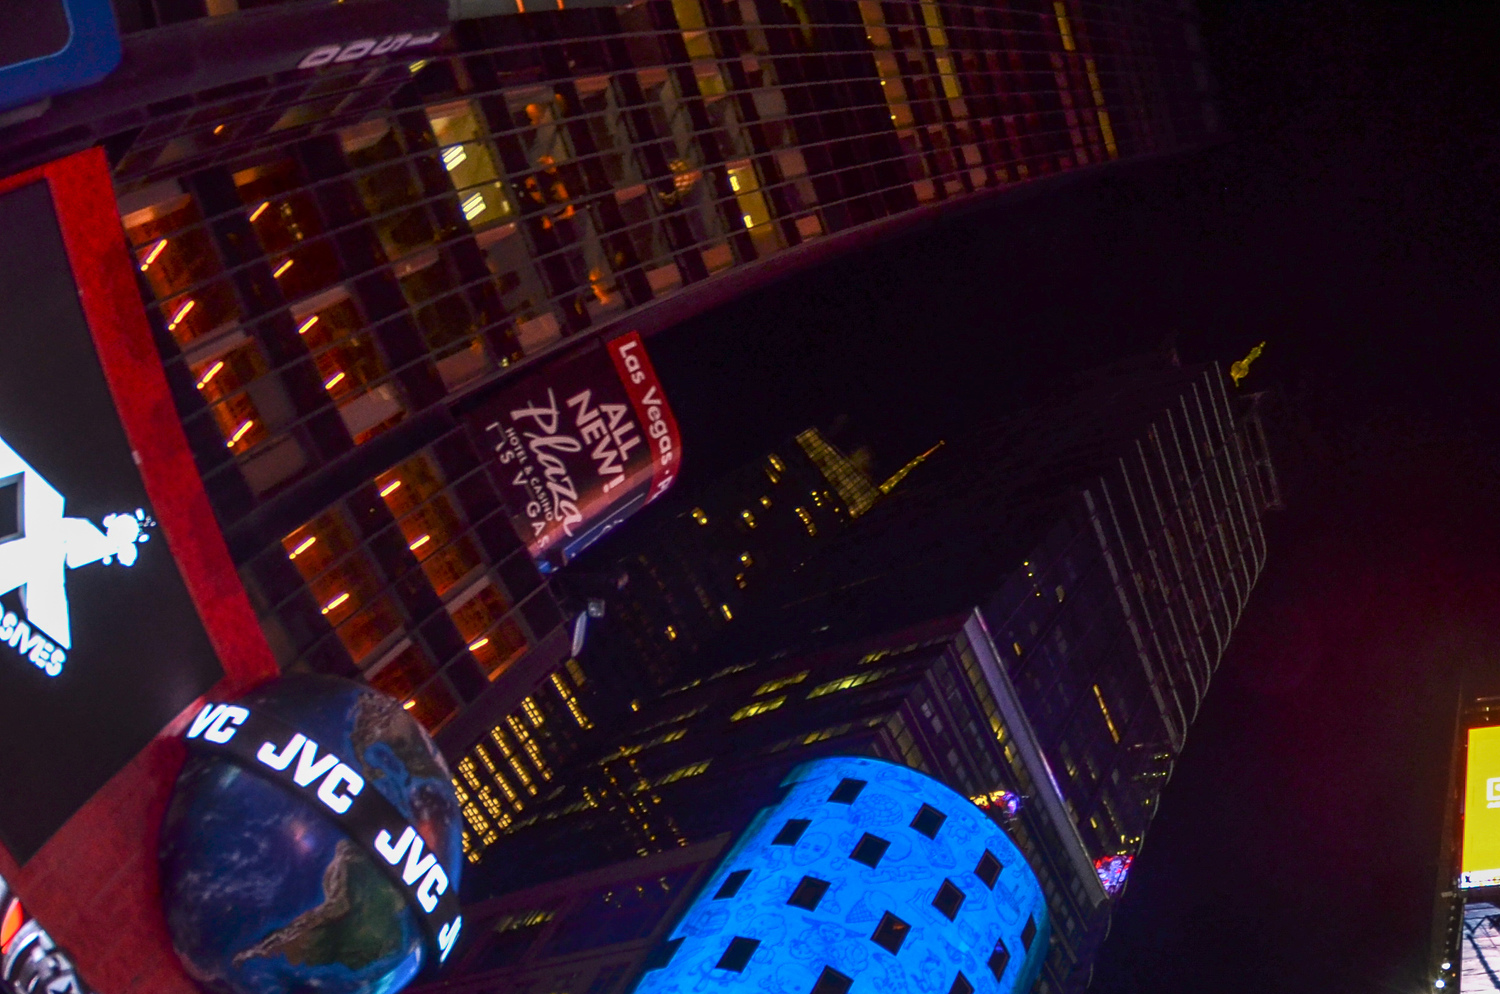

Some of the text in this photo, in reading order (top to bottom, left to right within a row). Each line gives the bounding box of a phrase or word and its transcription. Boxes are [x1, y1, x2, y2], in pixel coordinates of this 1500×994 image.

[566, 389, 625, 493] NEW!
[600, 404, 641, 461] ALL
[618, 341, 646, 384] Las
[642, 386, 672, 466] Vegas
[505, 427, 528, 465] HOTEL
[530, 477, 554, 521] CASINO
[511, 387, 582, 537] Plaza
[512, 470, 550, 548] VGAS
[0, 602, 67, 677] SIVES
[187, 704, 249, 743] VC
[257, 733, 364, 813] JVC
[374, 826, 448, 912] JVC
